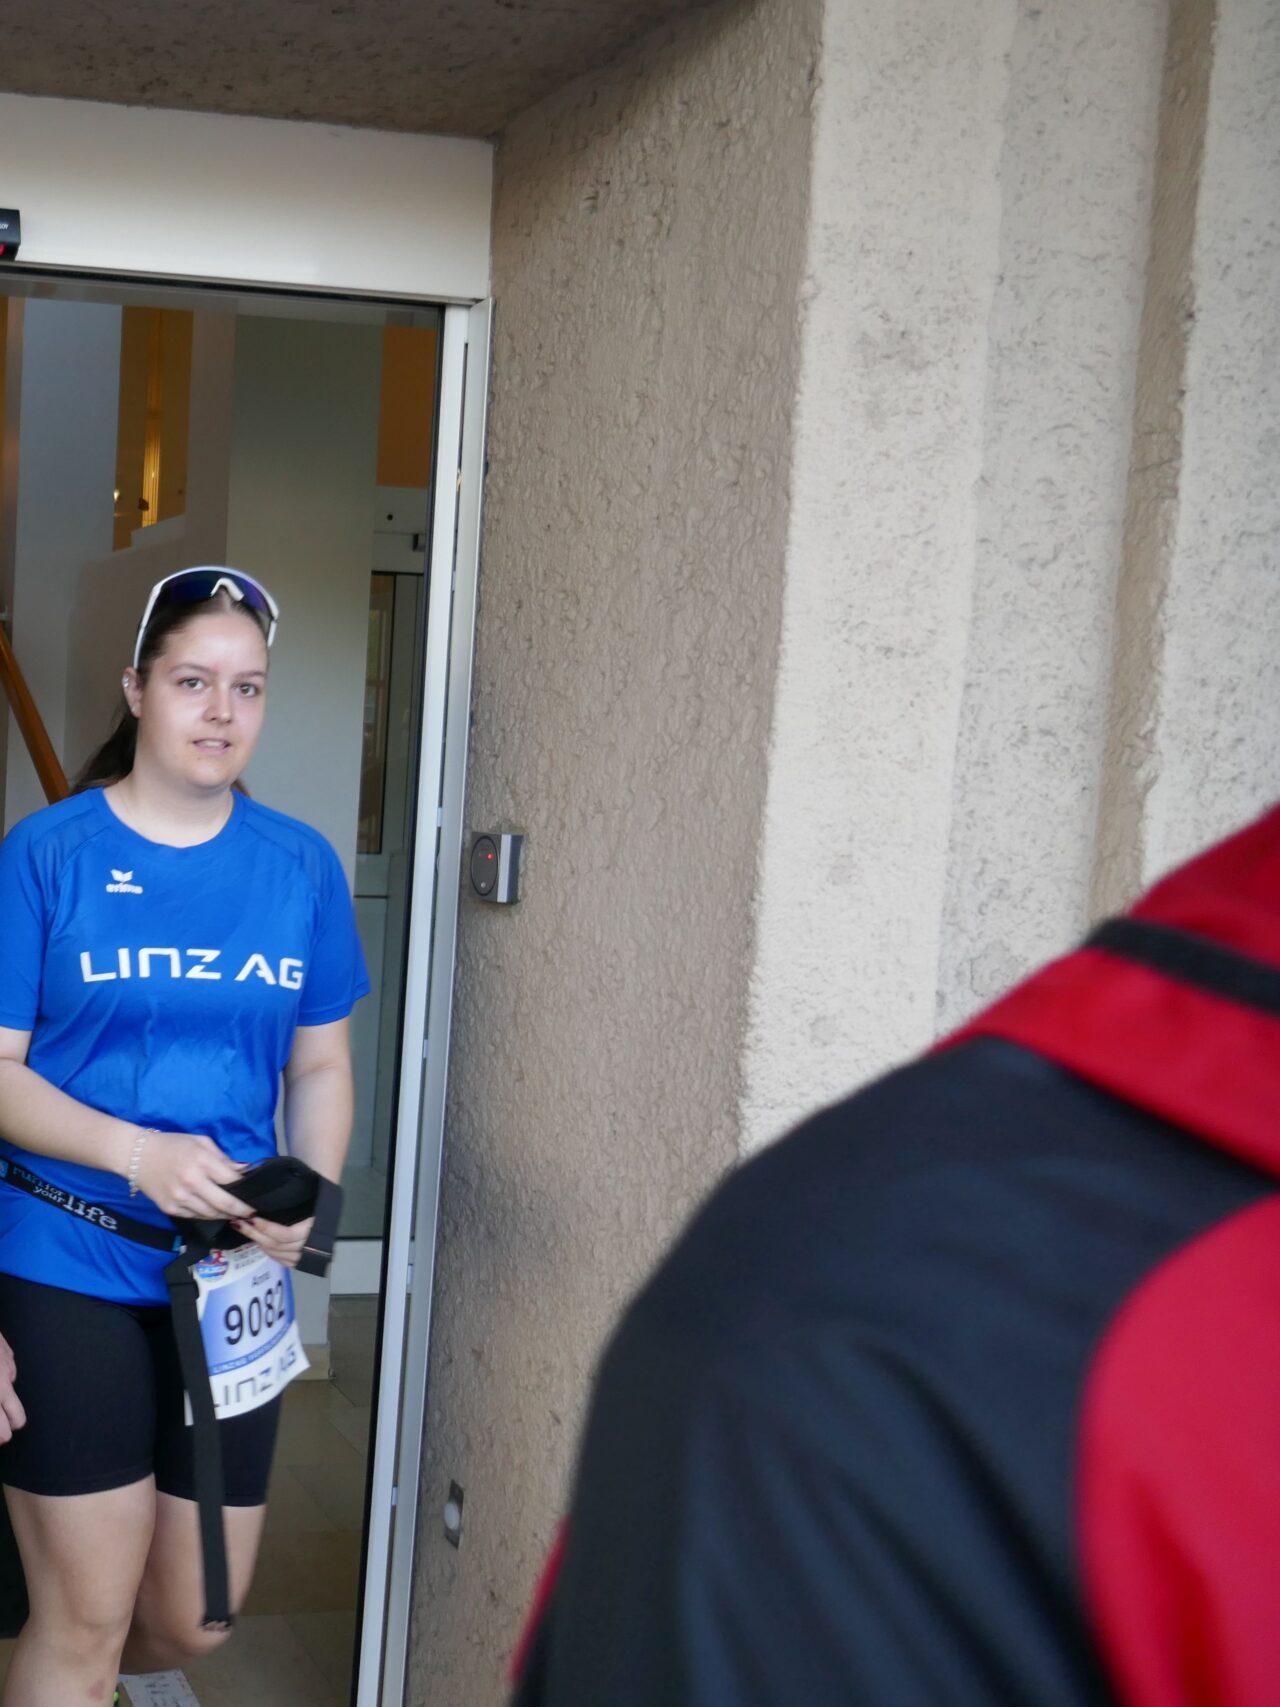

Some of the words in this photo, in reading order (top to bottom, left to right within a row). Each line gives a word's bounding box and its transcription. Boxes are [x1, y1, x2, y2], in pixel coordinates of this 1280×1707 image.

[79, 947, 222, 983] LINZ
[234, 953, 304, 991] AG
[32, 1185, 66, 1203] your
[63, 1196, 119, 1231] life
[224, 1279, 285, 1346] 9082
